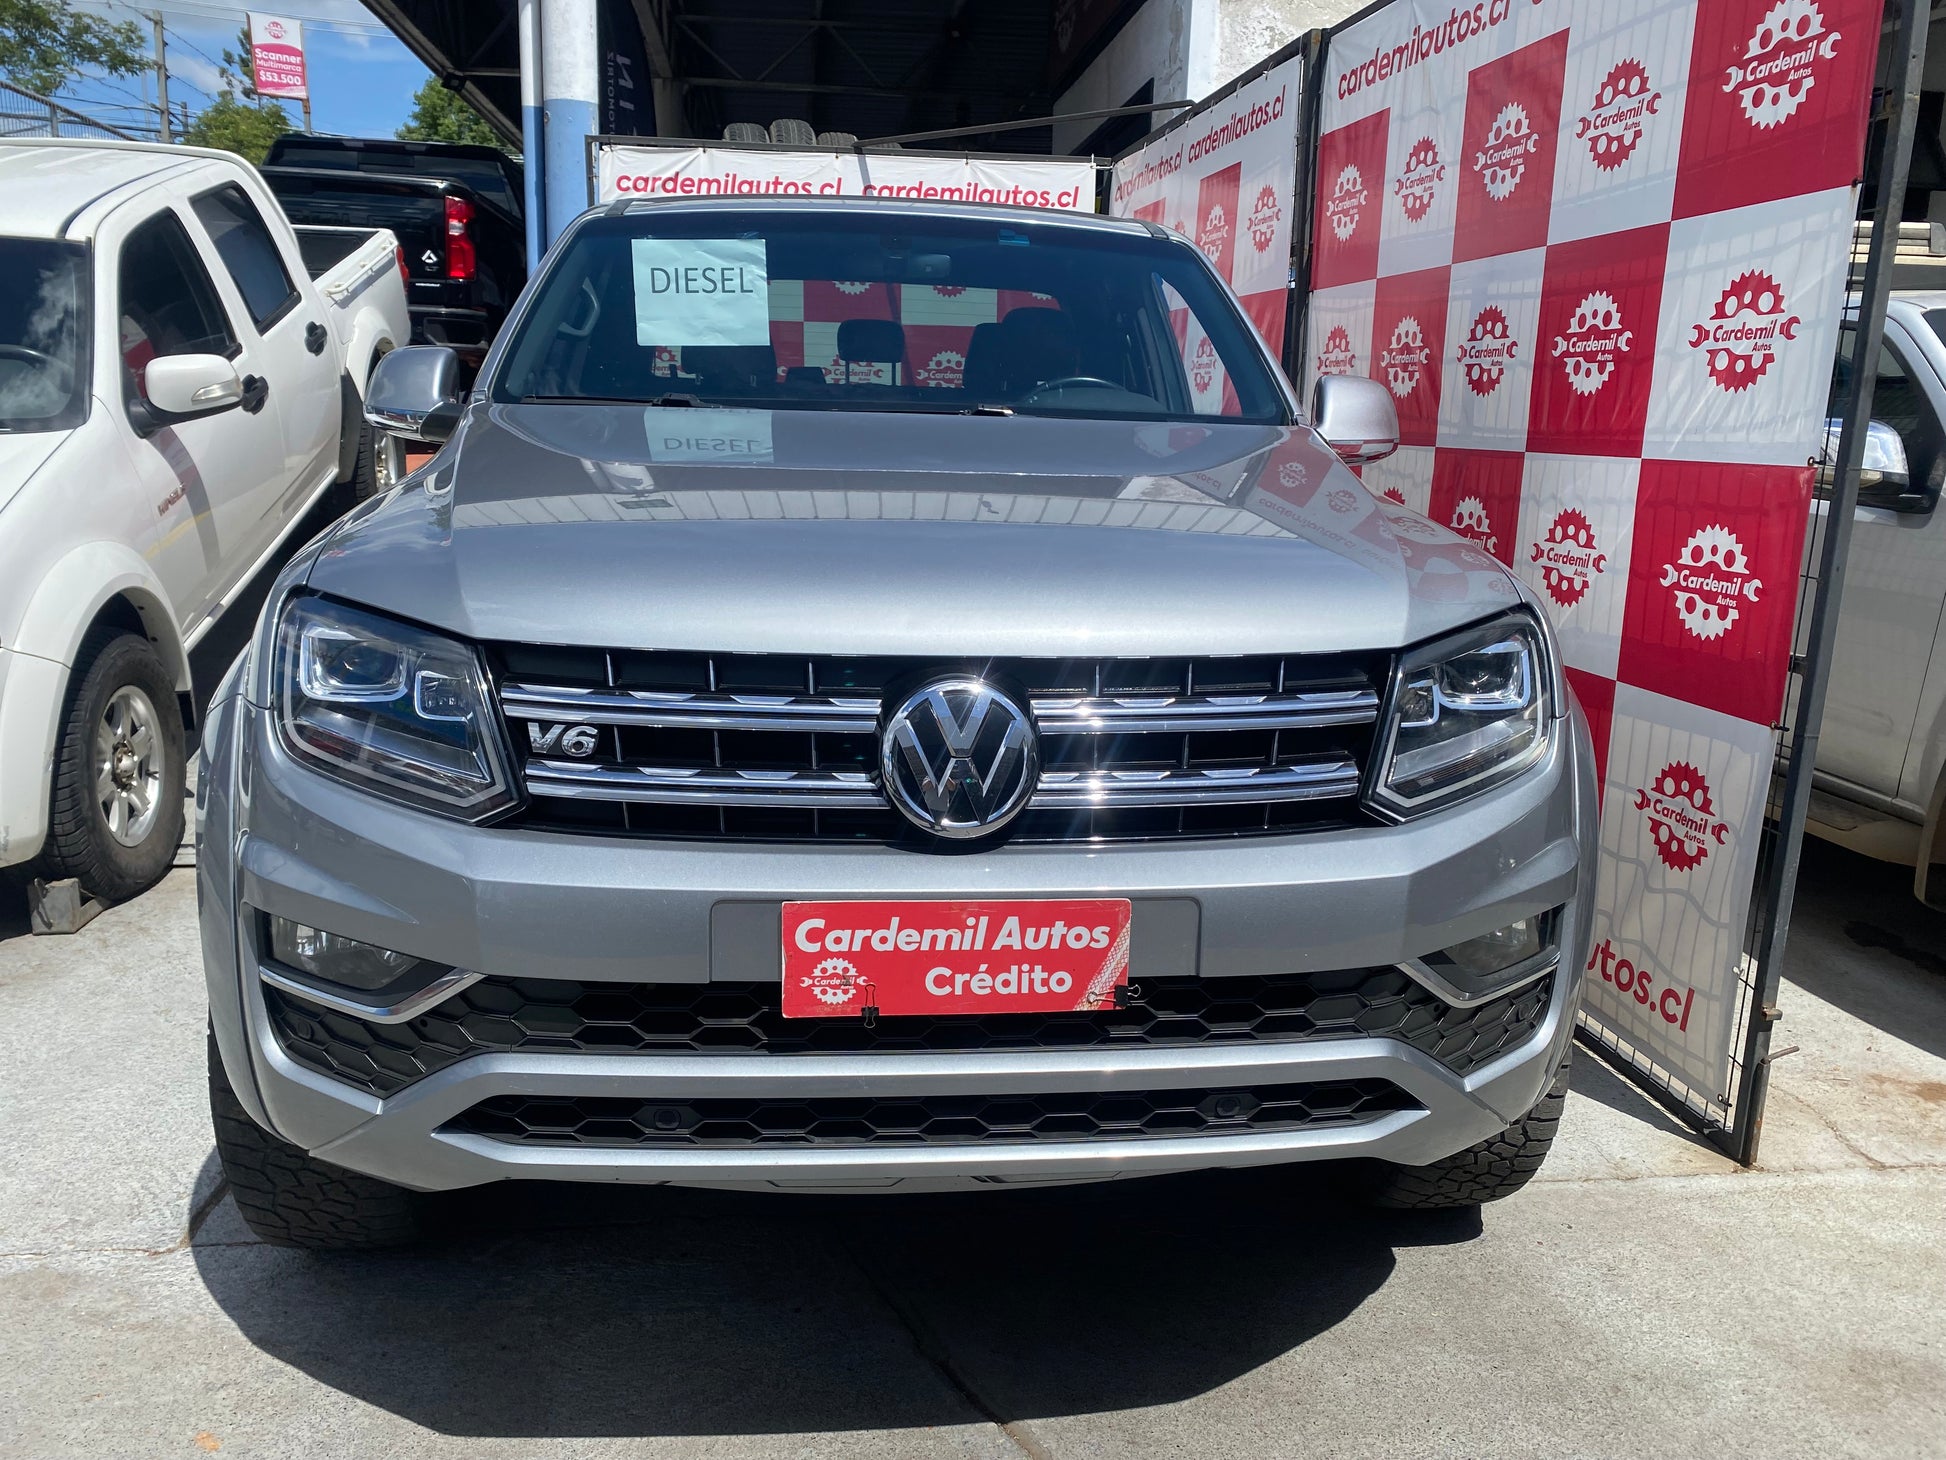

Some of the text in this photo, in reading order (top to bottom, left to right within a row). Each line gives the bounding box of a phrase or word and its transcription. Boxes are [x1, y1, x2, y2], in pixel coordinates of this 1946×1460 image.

[255, 48, 302, 63] Scanner
[256, 59, 302, 72] Multimarca
[1746, 40, 1817, 81] Cardemil
[259, 69, 302, 85] $53.500
[1787, 67, 1812, 81] Autos
[1188, 84, 1285, 164] cardemilautos.cl
[1593, 98, 1645, 130] Cardemil
[1623, 120, 1640, 131] Autos
[1487, 137, 1526, 164] Cardemil
[616, 171, 842, 195] cardemilautoscl
[1405, 168, 1436, 189] Cardemil
[862, 181, 1079, 207] cardemilautos.cl
[650, 267, 754, 294] DIESEL
[1713, 319, 1778, 343] Cardemil
[1469, 342, 1505, 359] Cardemil
[1569, 333, 1617, 353] Cardemil
[1752, 341, 1772, 352] Autos
[1391, 349, 1420, 364] Cardemil
[1596, 352, 1613, 361] Autos
[1547, 547, 1591, 569] Cardemil
[1680, 569, 1741, 596] Cardemil
[1716, 594, 1737, 608] Autos
[527, 722, 598, 757] V6
[1653, 798, 1709, 835] Cardemil
[1683, 830, 1706, 846] Autos
[795, 916, 1110, 953] Cardemil Autos
[925, 963, 1073, 996] Crédito
